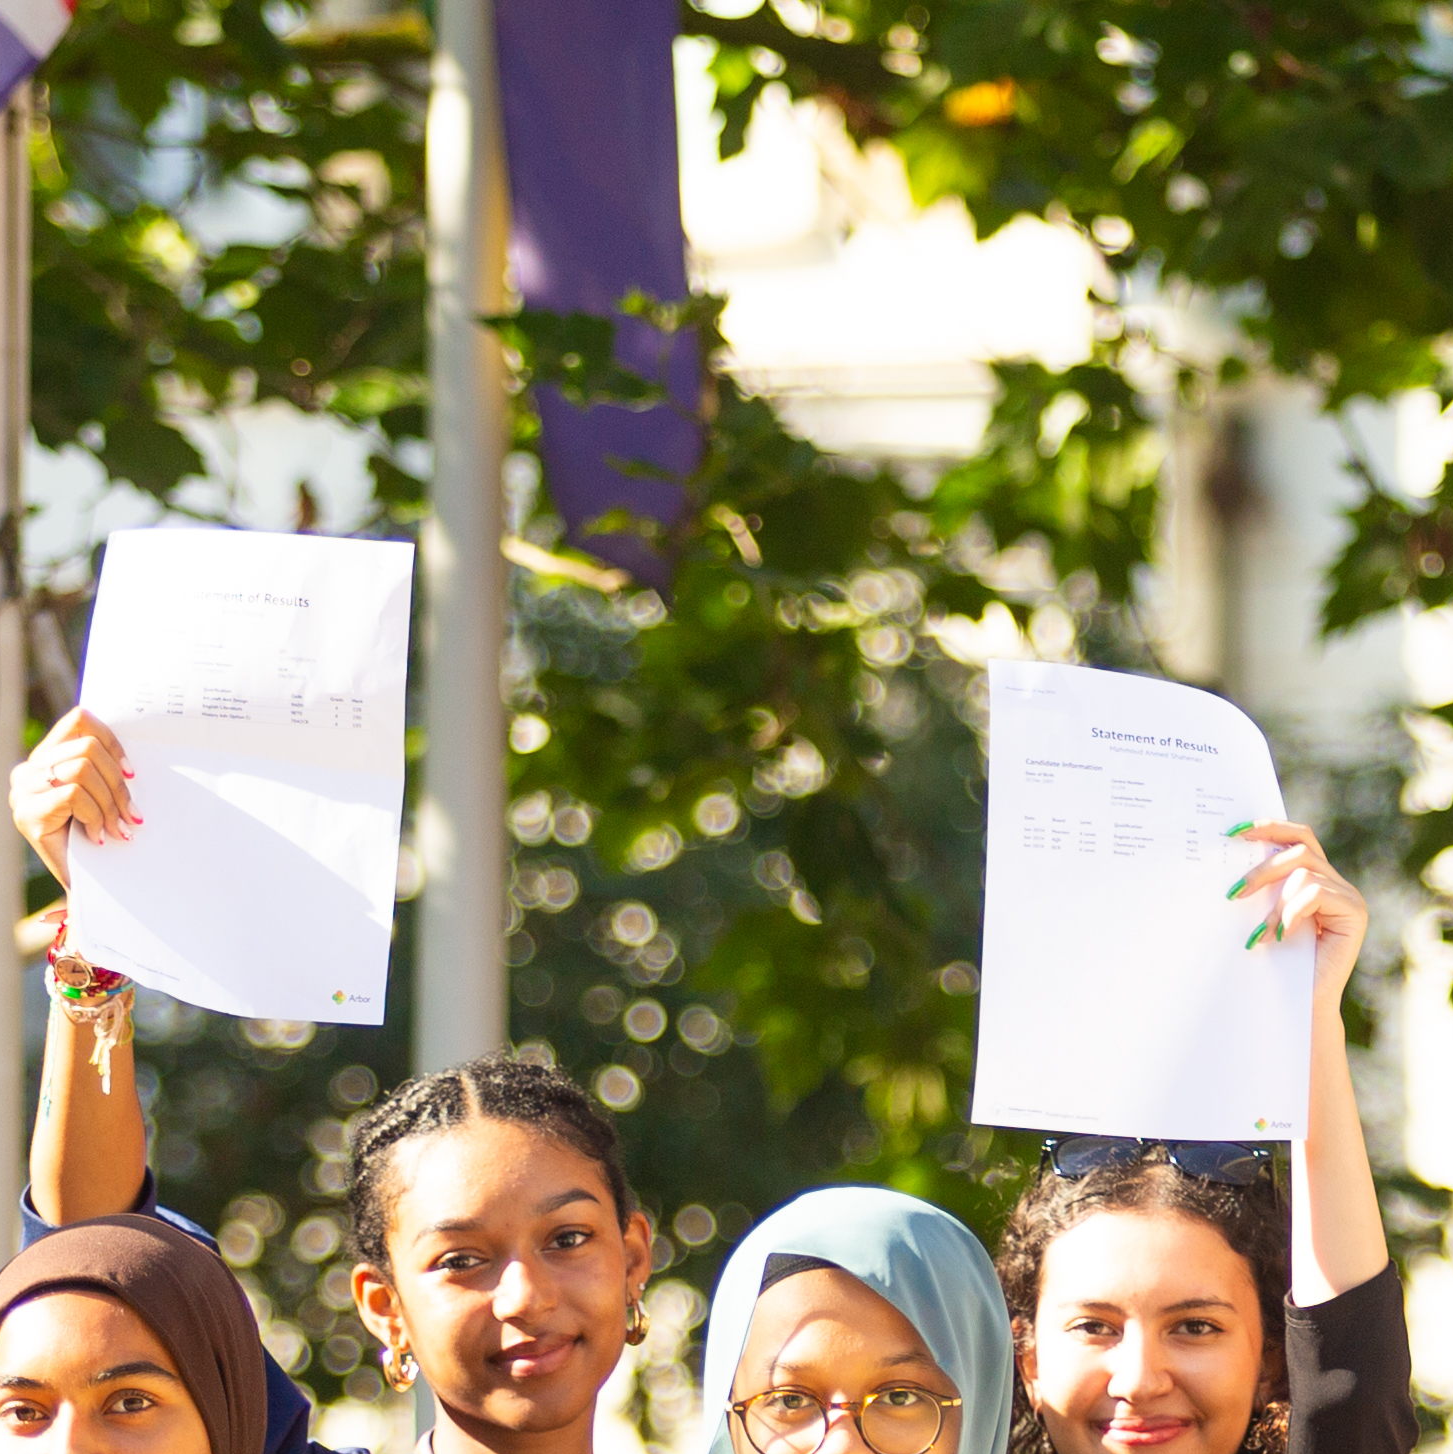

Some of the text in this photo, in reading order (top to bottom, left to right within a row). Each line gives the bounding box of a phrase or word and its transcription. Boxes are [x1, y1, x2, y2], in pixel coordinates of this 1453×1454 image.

[248, 592, 260, 604] of
[264, 593, 310, 608] Results
[1091, 727, 1219, 755] Statement of Results
[1025, 758, 1103, 771] Candidate Information
[348, 994, 372, 1004] Arbor
[1270, 1120, 1293, 1129] Arbor
